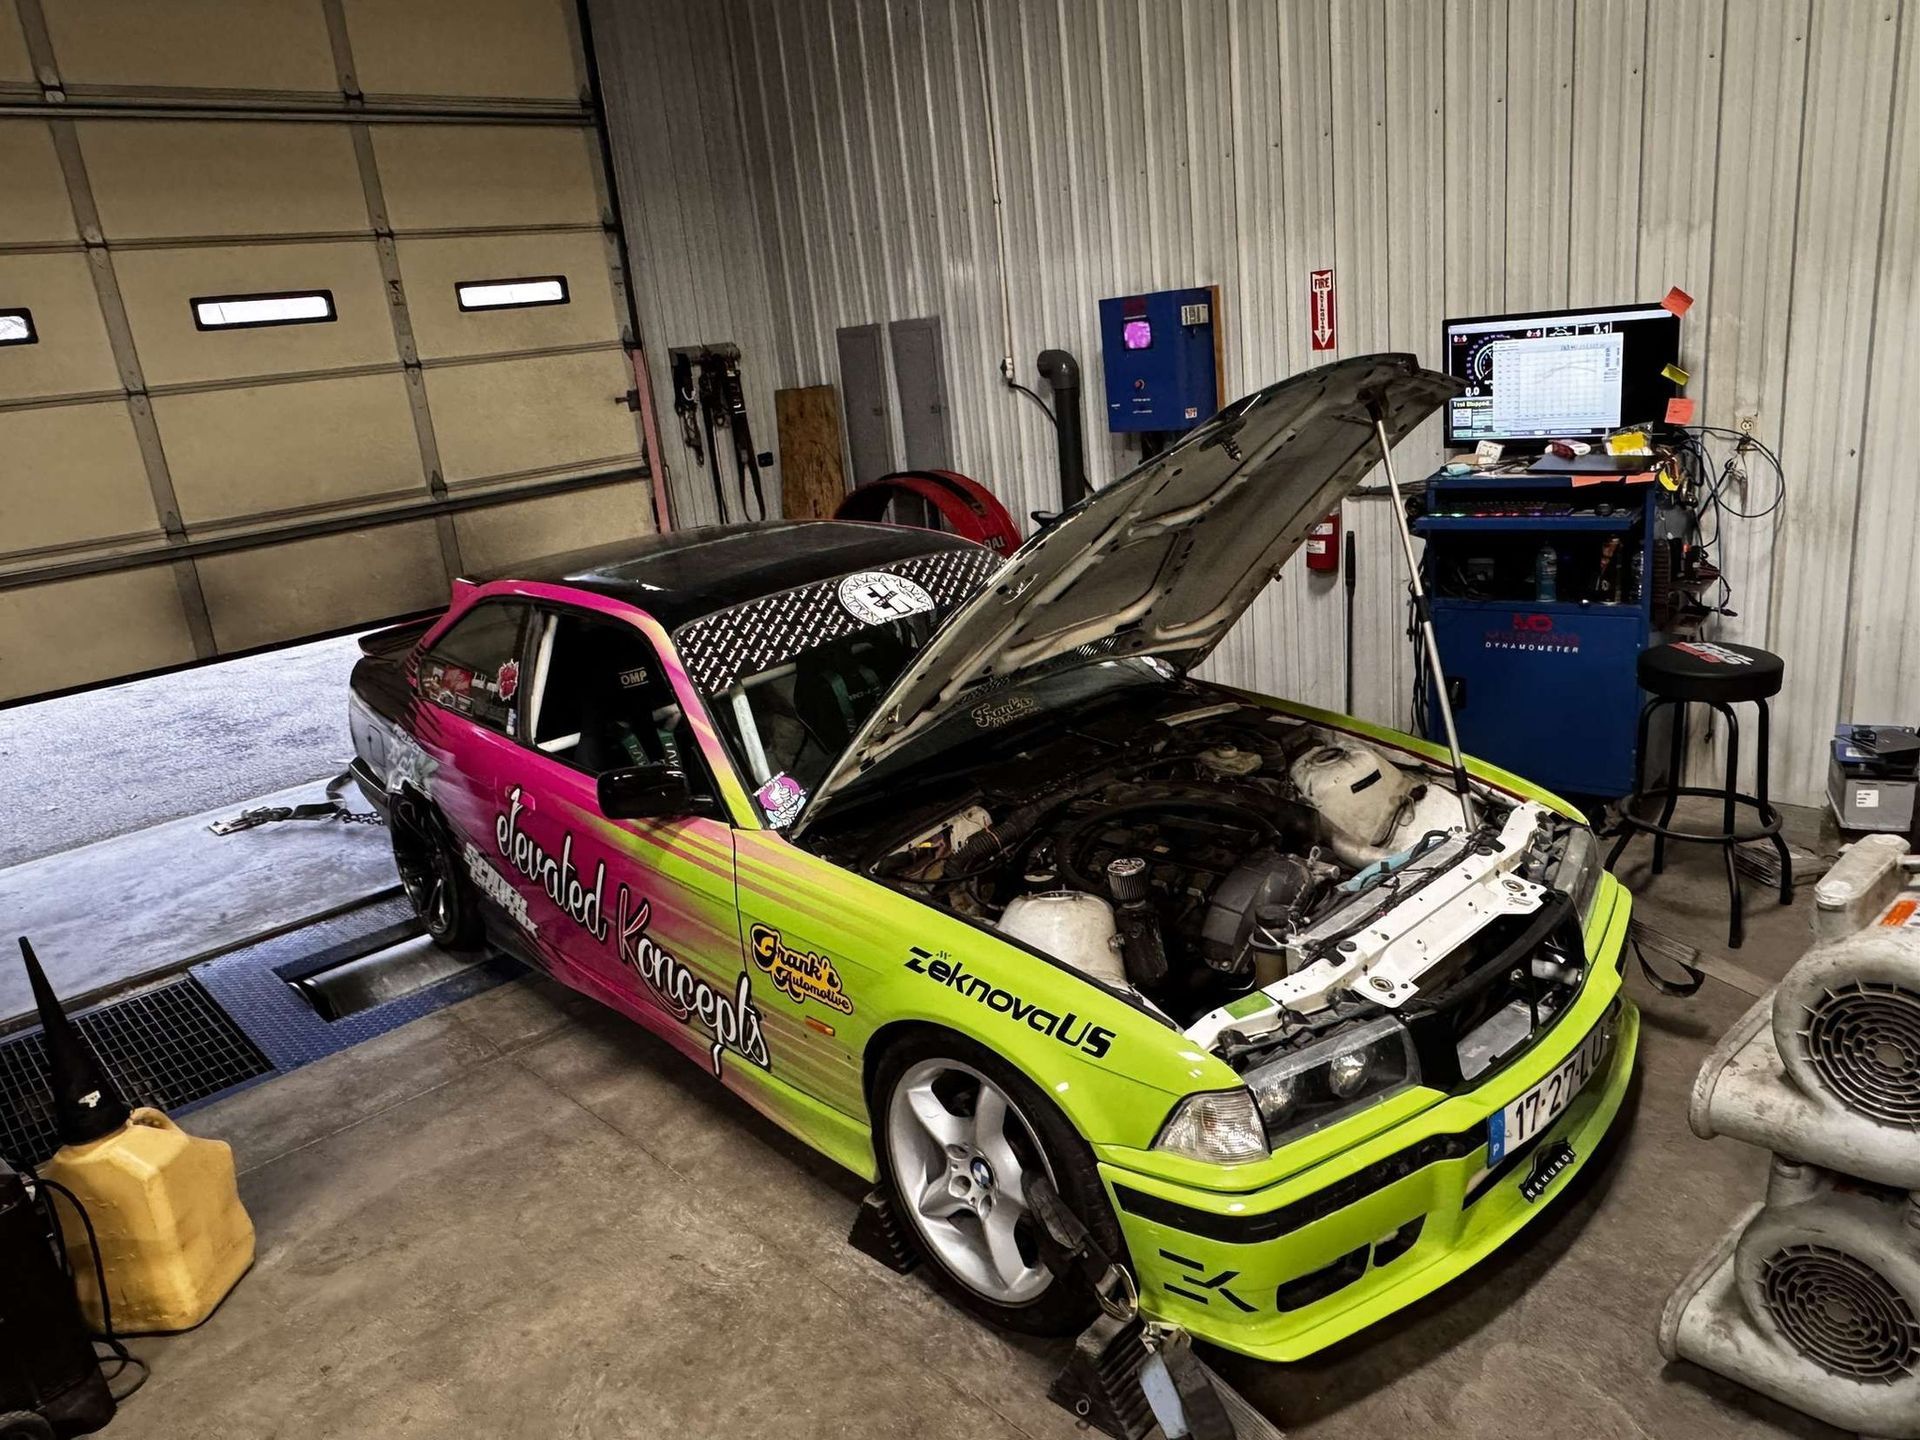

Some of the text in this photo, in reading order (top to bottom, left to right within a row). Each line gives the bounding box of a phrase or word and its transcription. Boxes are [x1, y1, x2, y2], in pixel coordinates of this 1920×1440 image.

[1314, 277, 1330, 290] FIRE
[1484, 641, 1580, 654] DYNAMOMETER
[620, 670, 647, 685] OMP
[752, 926, 840, 989] Frank's
[774, 965, 851, 1011] Automotive
